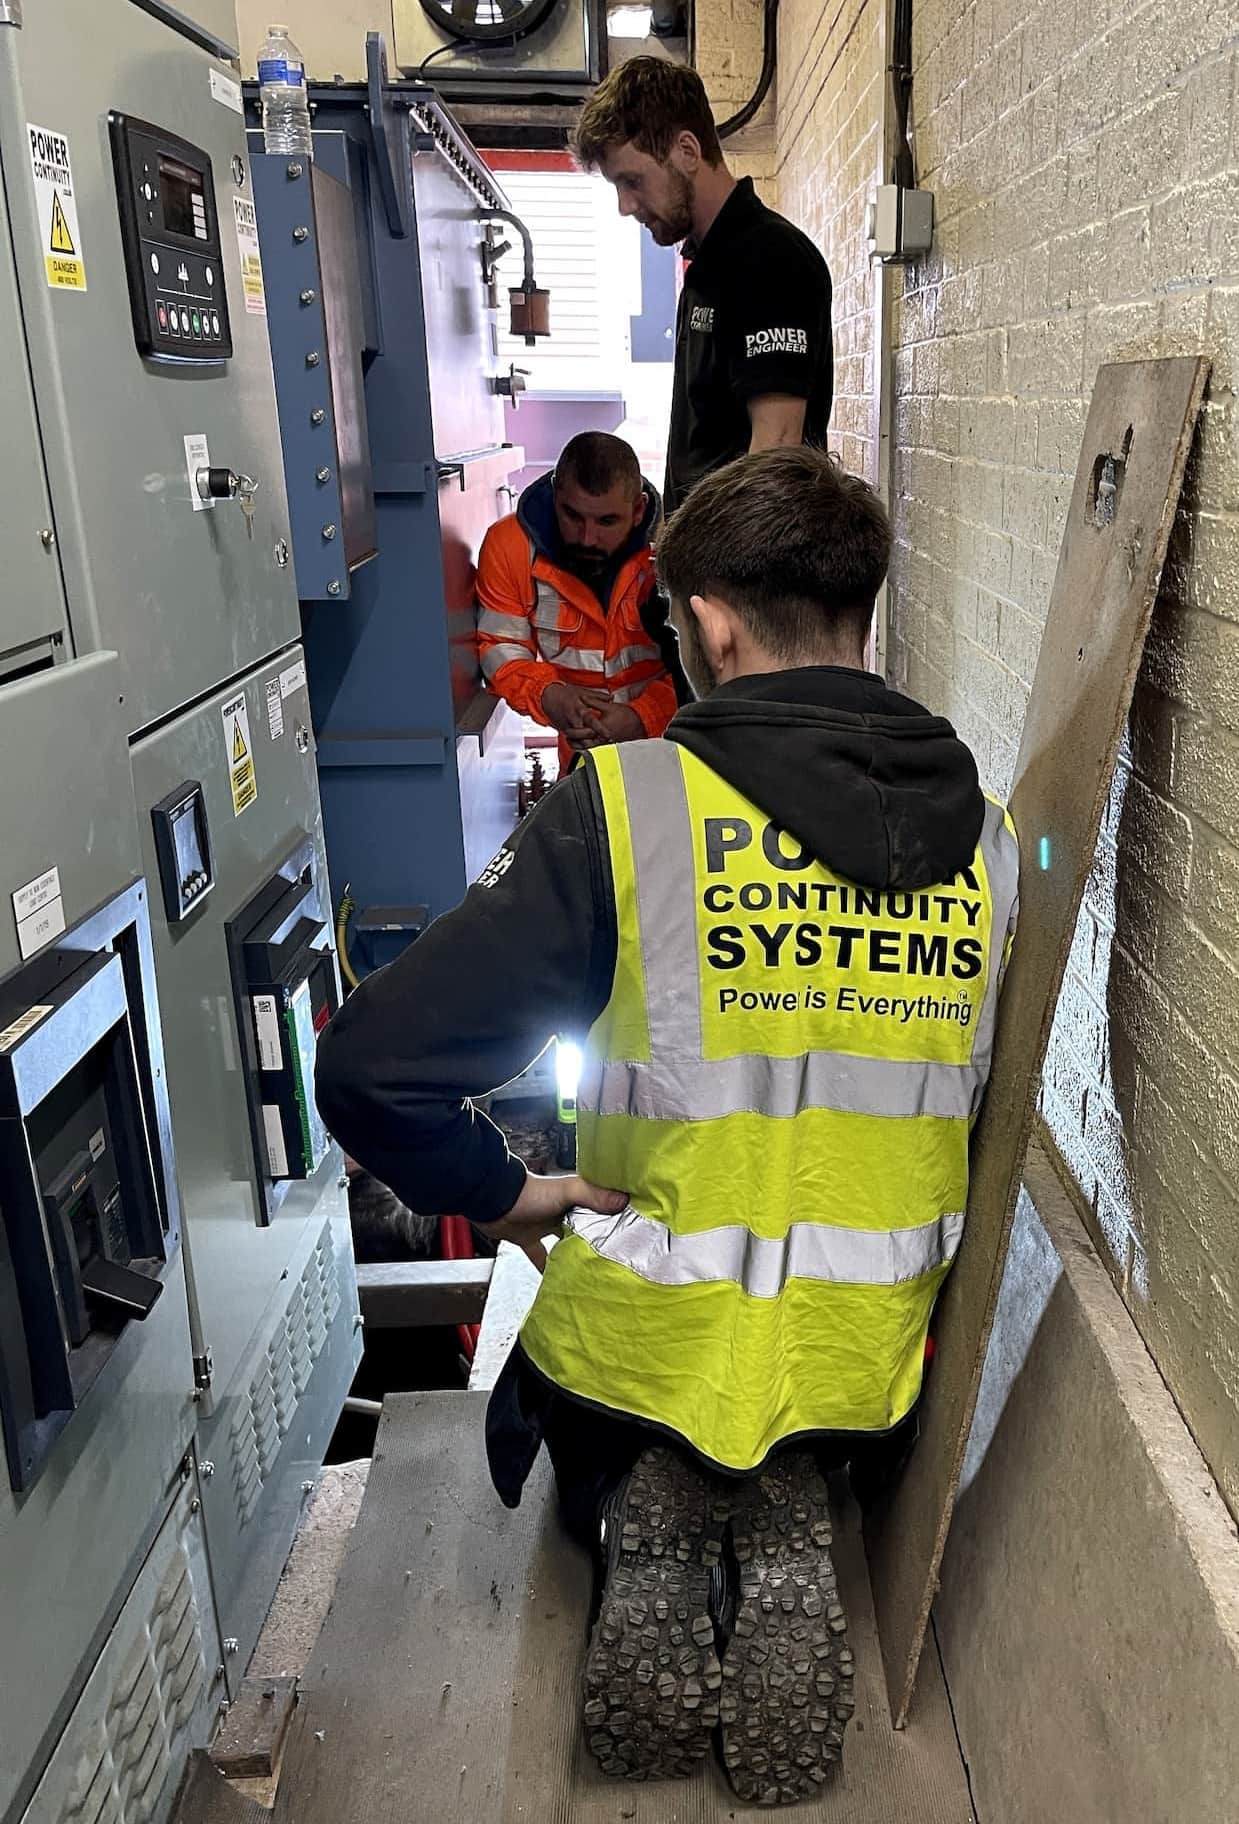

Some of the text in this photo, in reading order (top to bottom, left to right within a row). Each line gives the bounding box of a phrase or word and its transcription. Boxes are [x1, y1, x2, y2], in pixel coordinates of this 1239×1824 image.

[30, 129, 69, 167] POWER
[34, 162, 71, 186] CONTINUITY
[53, 260, 78, 274] DANGER
[691, 306, 715, 323] POWE
[745, 327, 808, 348] POWER
[746, 341, 808, 358] ENGINEER
[703, 882, 982, 927] CONTINUITY
[707, 923, 983, 979] SYSTEMS
[719, 985, 972, 1026] Powe is Everything
